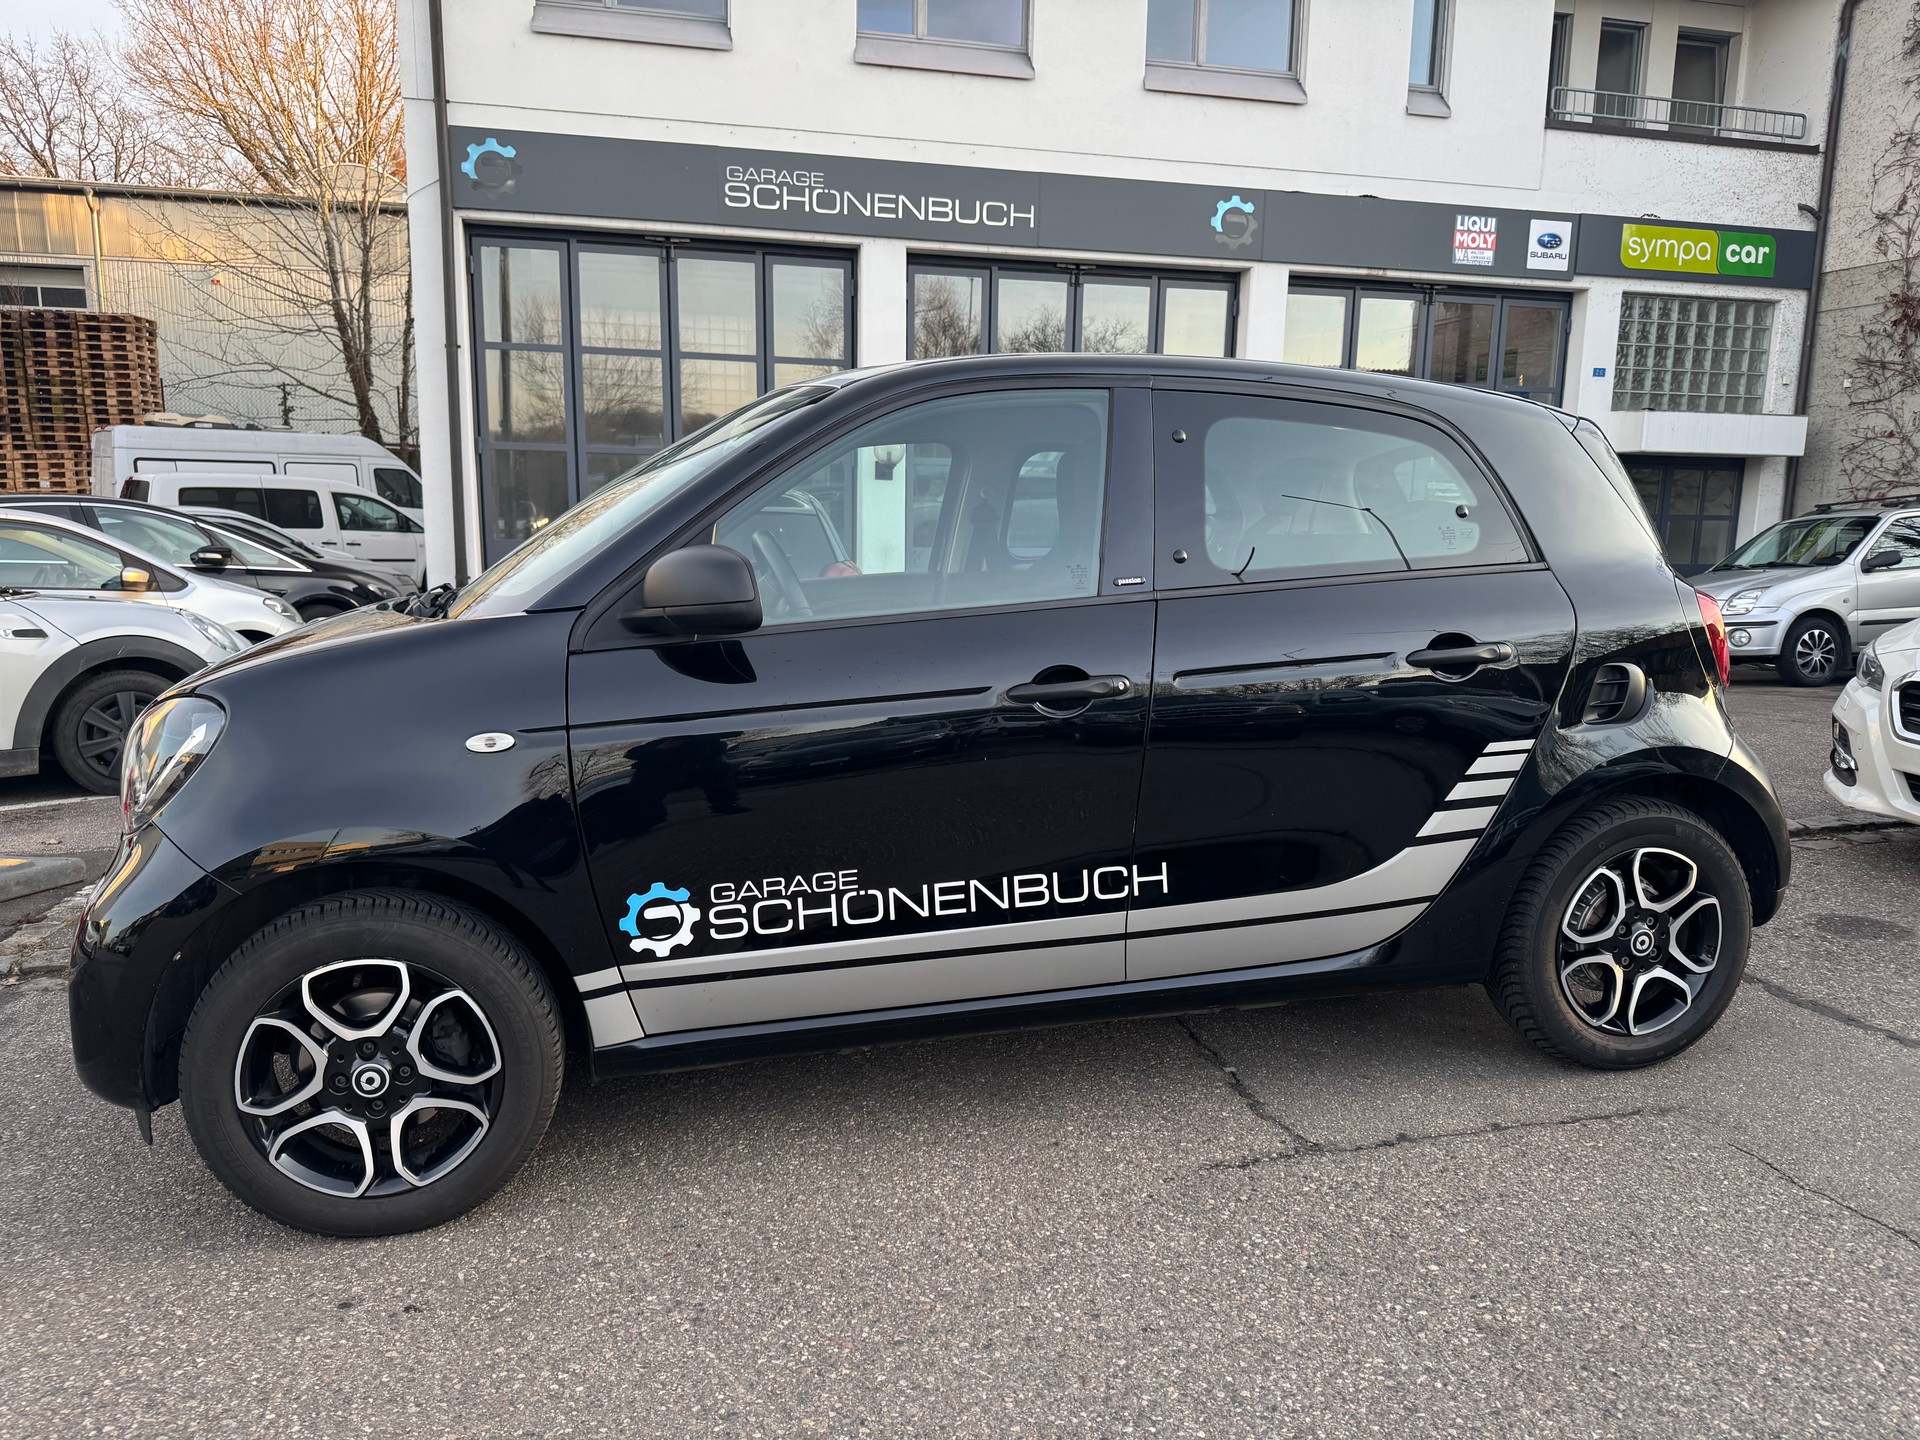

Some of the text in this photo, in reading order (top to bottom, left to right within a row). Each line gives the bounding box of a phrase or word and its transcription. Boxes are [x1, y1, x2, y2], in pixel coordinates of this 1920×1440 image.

[726, 165, 825, 188] GARAGE
[724, 181, 1035, 229] SCHÖNENBUCH
[1456, 215, 1496, 232] LIQUI
[1455, 232, 1496, 248] MOLY
[1628, 236, 1769, 266] sympa car
[1529, 251, 1567, 260] SUBARU
[710, 869, 859, 904] GARAGE
[708, 861, 1169, 940] SCHÖNENBUCH
